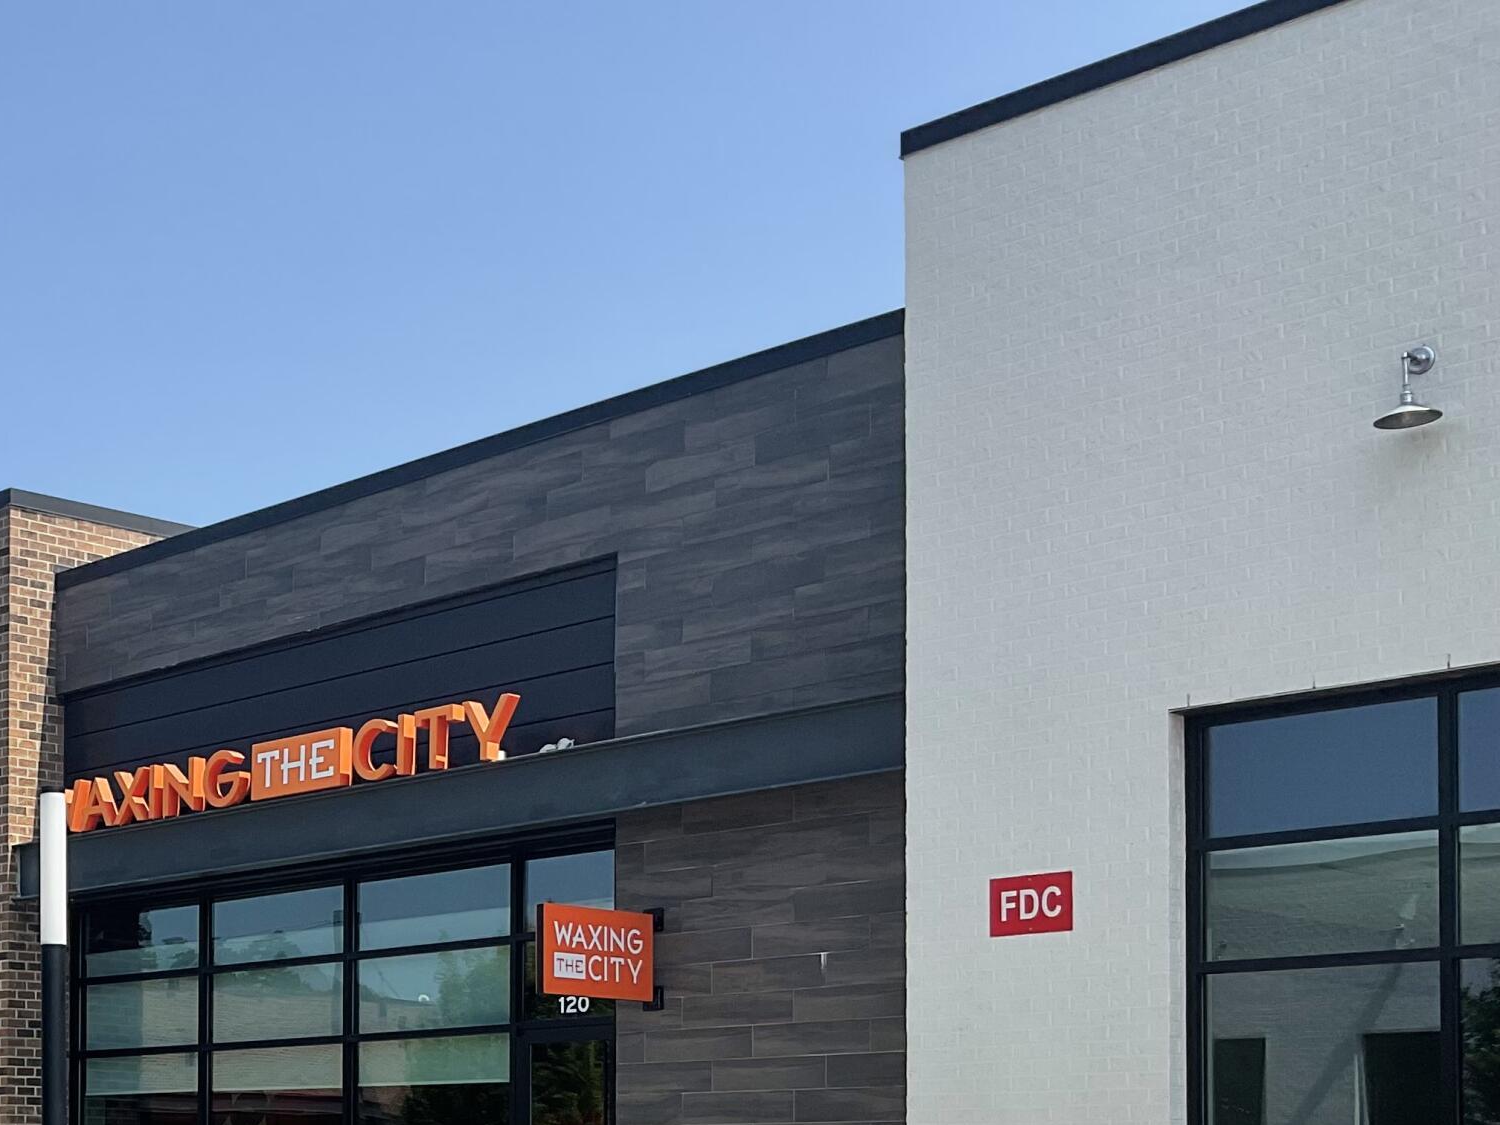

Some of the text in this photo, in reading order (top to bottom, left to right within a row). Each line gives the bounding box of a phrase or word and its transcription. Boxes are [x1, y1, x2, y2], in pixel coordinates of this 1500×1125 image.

[256, 738, 336, 789] THE
[353, 693, 521, 782] CITY
[1000, 885, 1062, 923] FDC
[553, 920, 644, 955] WAXING
[556, 955, 643, 985] THE CITY
[558, 996, 590, 1014] 120
